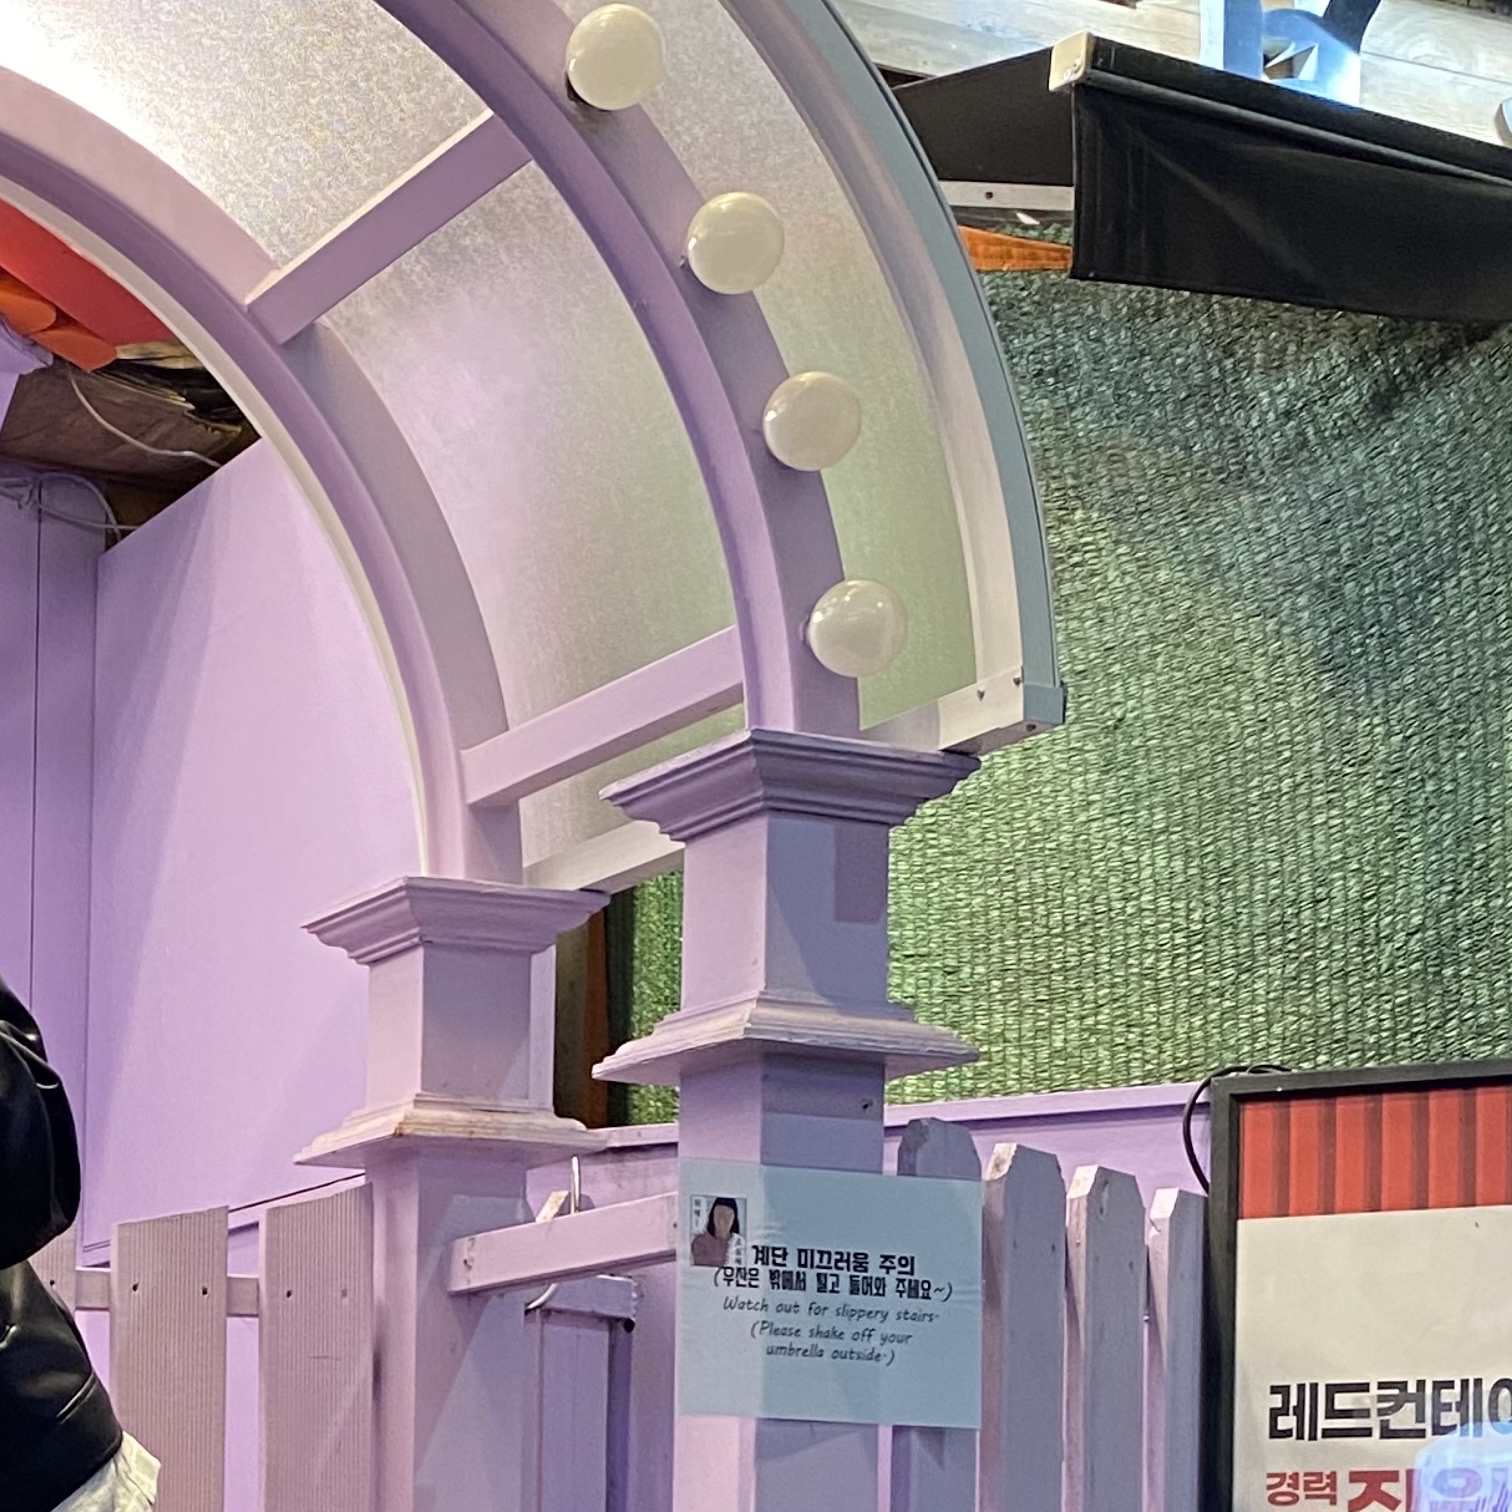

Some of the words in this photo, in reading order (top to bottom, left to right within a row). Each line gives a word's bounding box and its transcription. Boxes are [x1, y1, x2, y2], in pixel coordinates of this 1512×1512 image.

[751, 1245, 789, 1267] 계단
[797, 1248, 870, 1274] 미끄러움
[879, 1254, 915, 1276] 주의
[769, 1269, 806, 1291] 밖에서
[849, 1274, 886, 1297] 들어와
[723, 1296, 769, 1312] Watch
[776, 1301, 800, 1313] out
[807, 1301, 828, 1315] for
[835, 1303, 889, 1323] slippery
[750, 1320, 802, 1339] (Please
[809, 1325, 845, 1340] shake
[852, 1328, 876, 1342] off
[880, 1333, 913, 1346] your
[766, 1341, 825, 1357] umbrella
[1265, 1470, 1337, 1506] 경력
